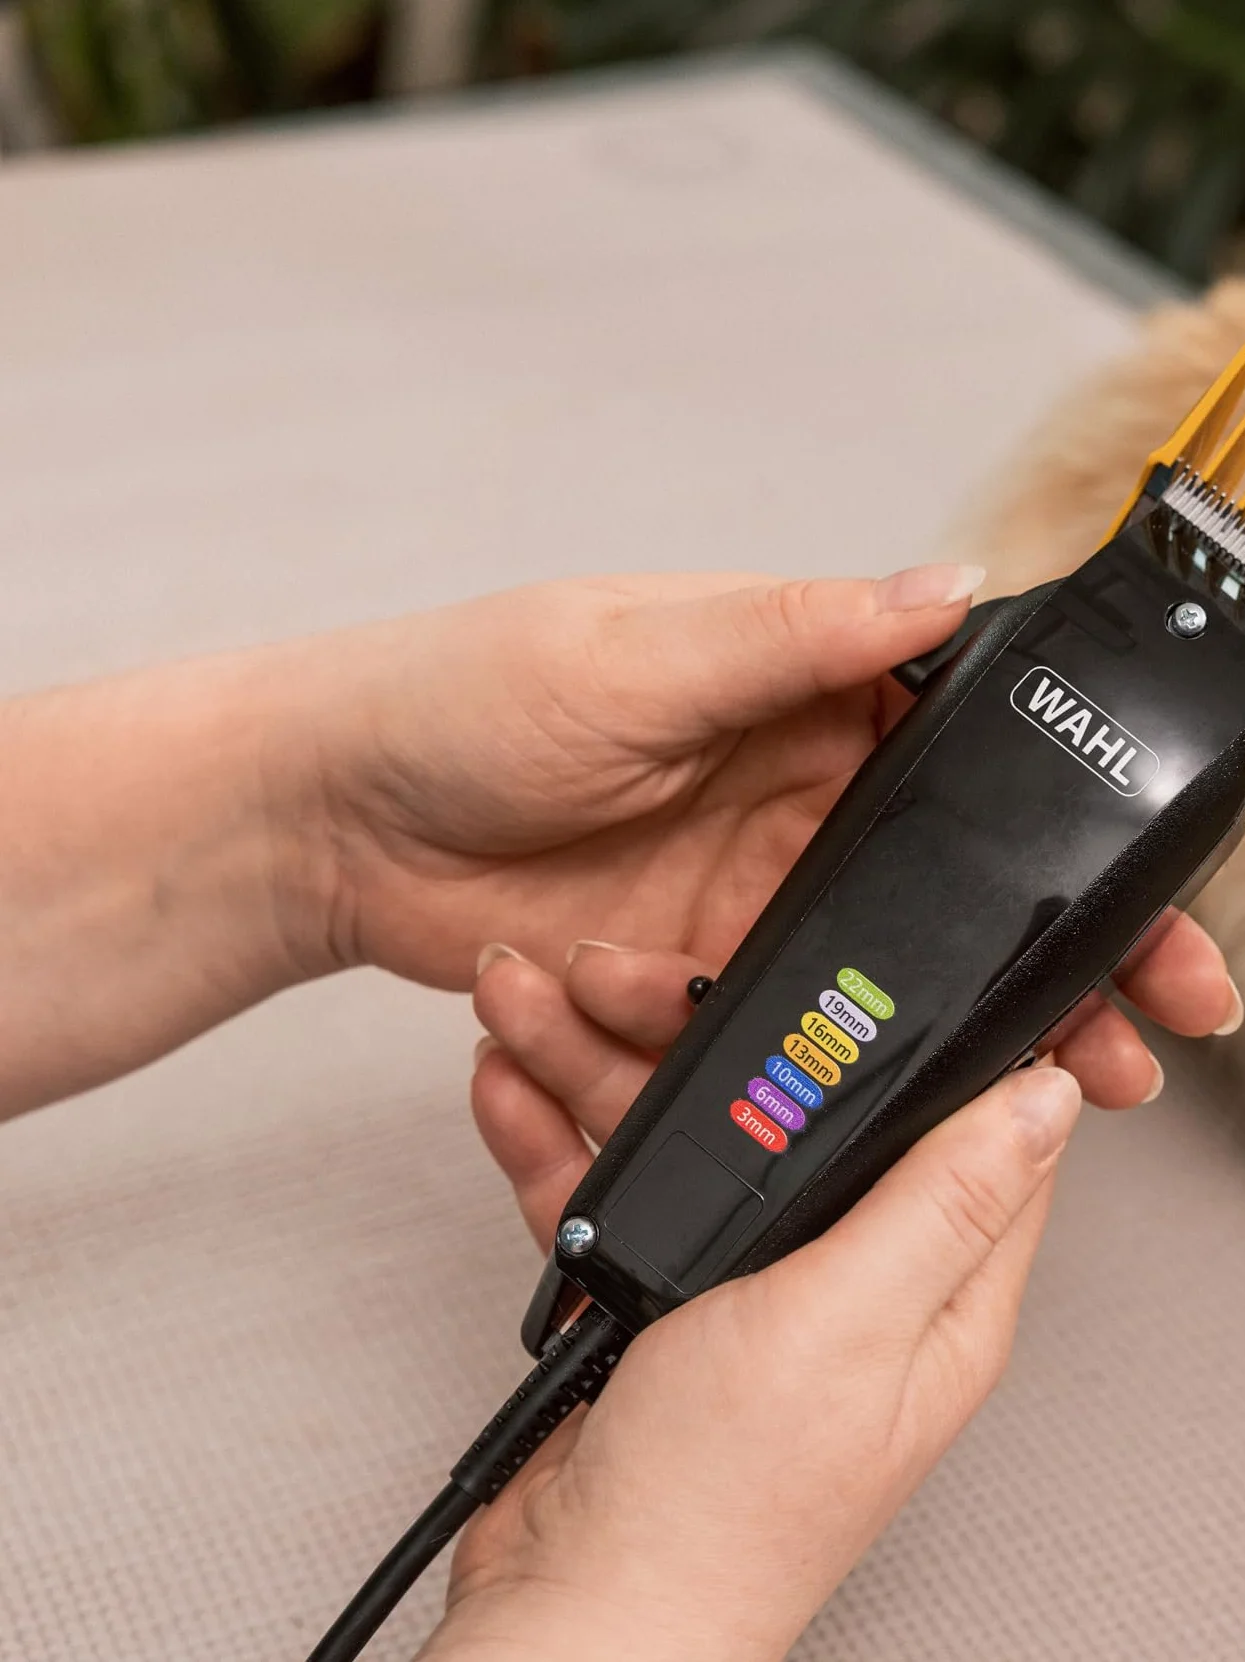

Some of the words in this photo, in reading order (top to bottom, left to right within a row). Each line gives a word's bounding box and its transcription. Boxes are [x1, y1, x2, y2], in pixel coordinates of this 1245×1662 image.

[1028, 677, 1137, 786] WAHL
[840, 971, 887, 1017] 22mm
[825, 995, 868, 1038] 19mm
[807, 1017, 851, 1060] 16mm
[789, 1039, 833, 1082] 13mm
[771, 1061, 816, 1105] 10mm
[737, 1108, 776, 1145] 3mm
[756, 1086, 794, 1124] 6mm
